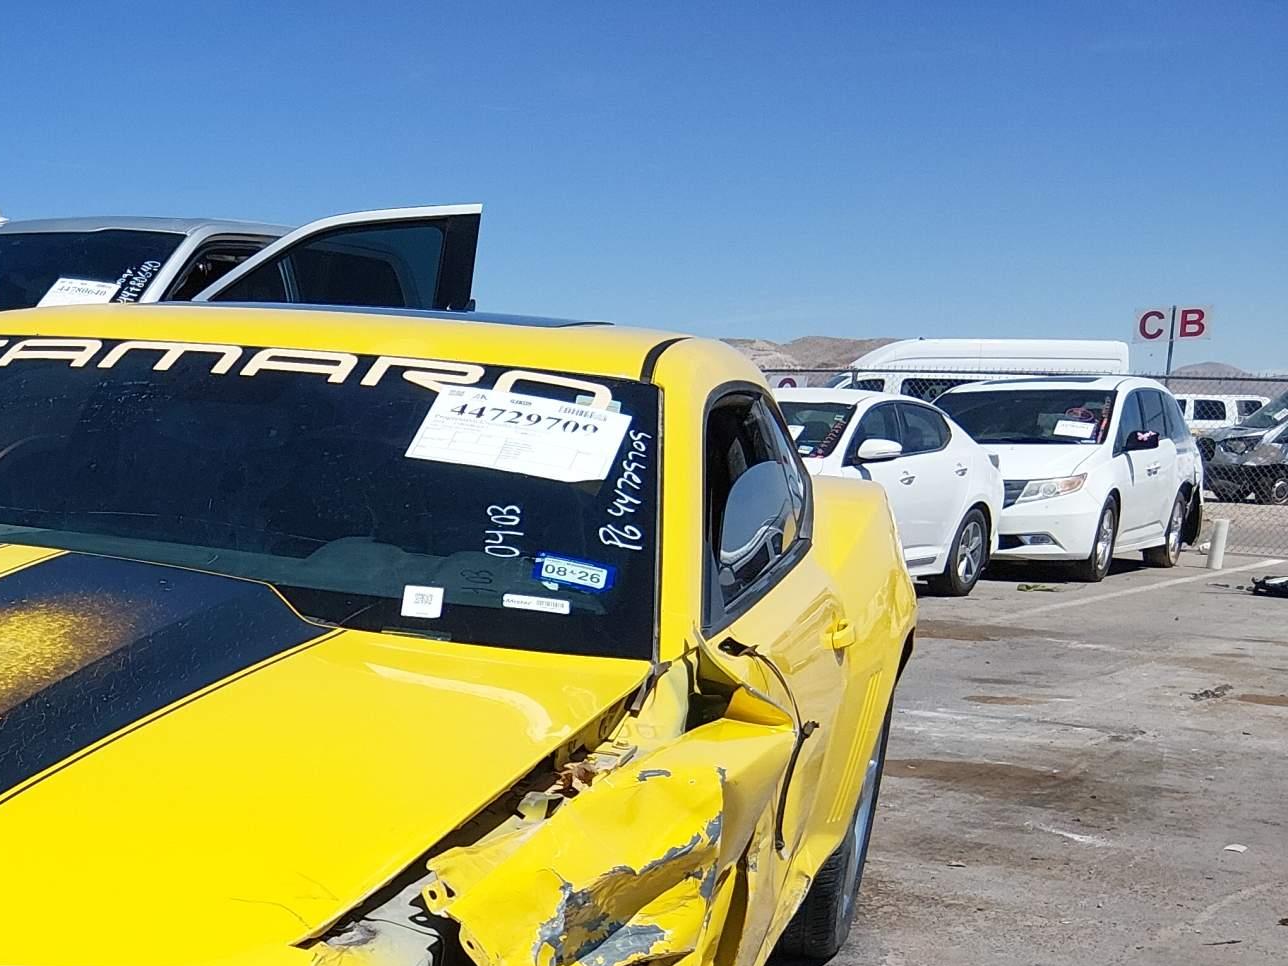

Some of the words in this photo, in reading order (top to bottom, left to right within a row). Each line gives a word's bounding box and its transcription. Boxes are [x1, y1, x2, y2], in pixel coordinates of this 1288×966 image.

[1139, 310, 1165, 339] C
[1179, 308, 1205, 337] B
[450, 402, 600, 434] 44729709
[544, 563, 568, 577] 08
[577, 570, 601, 584] 26
